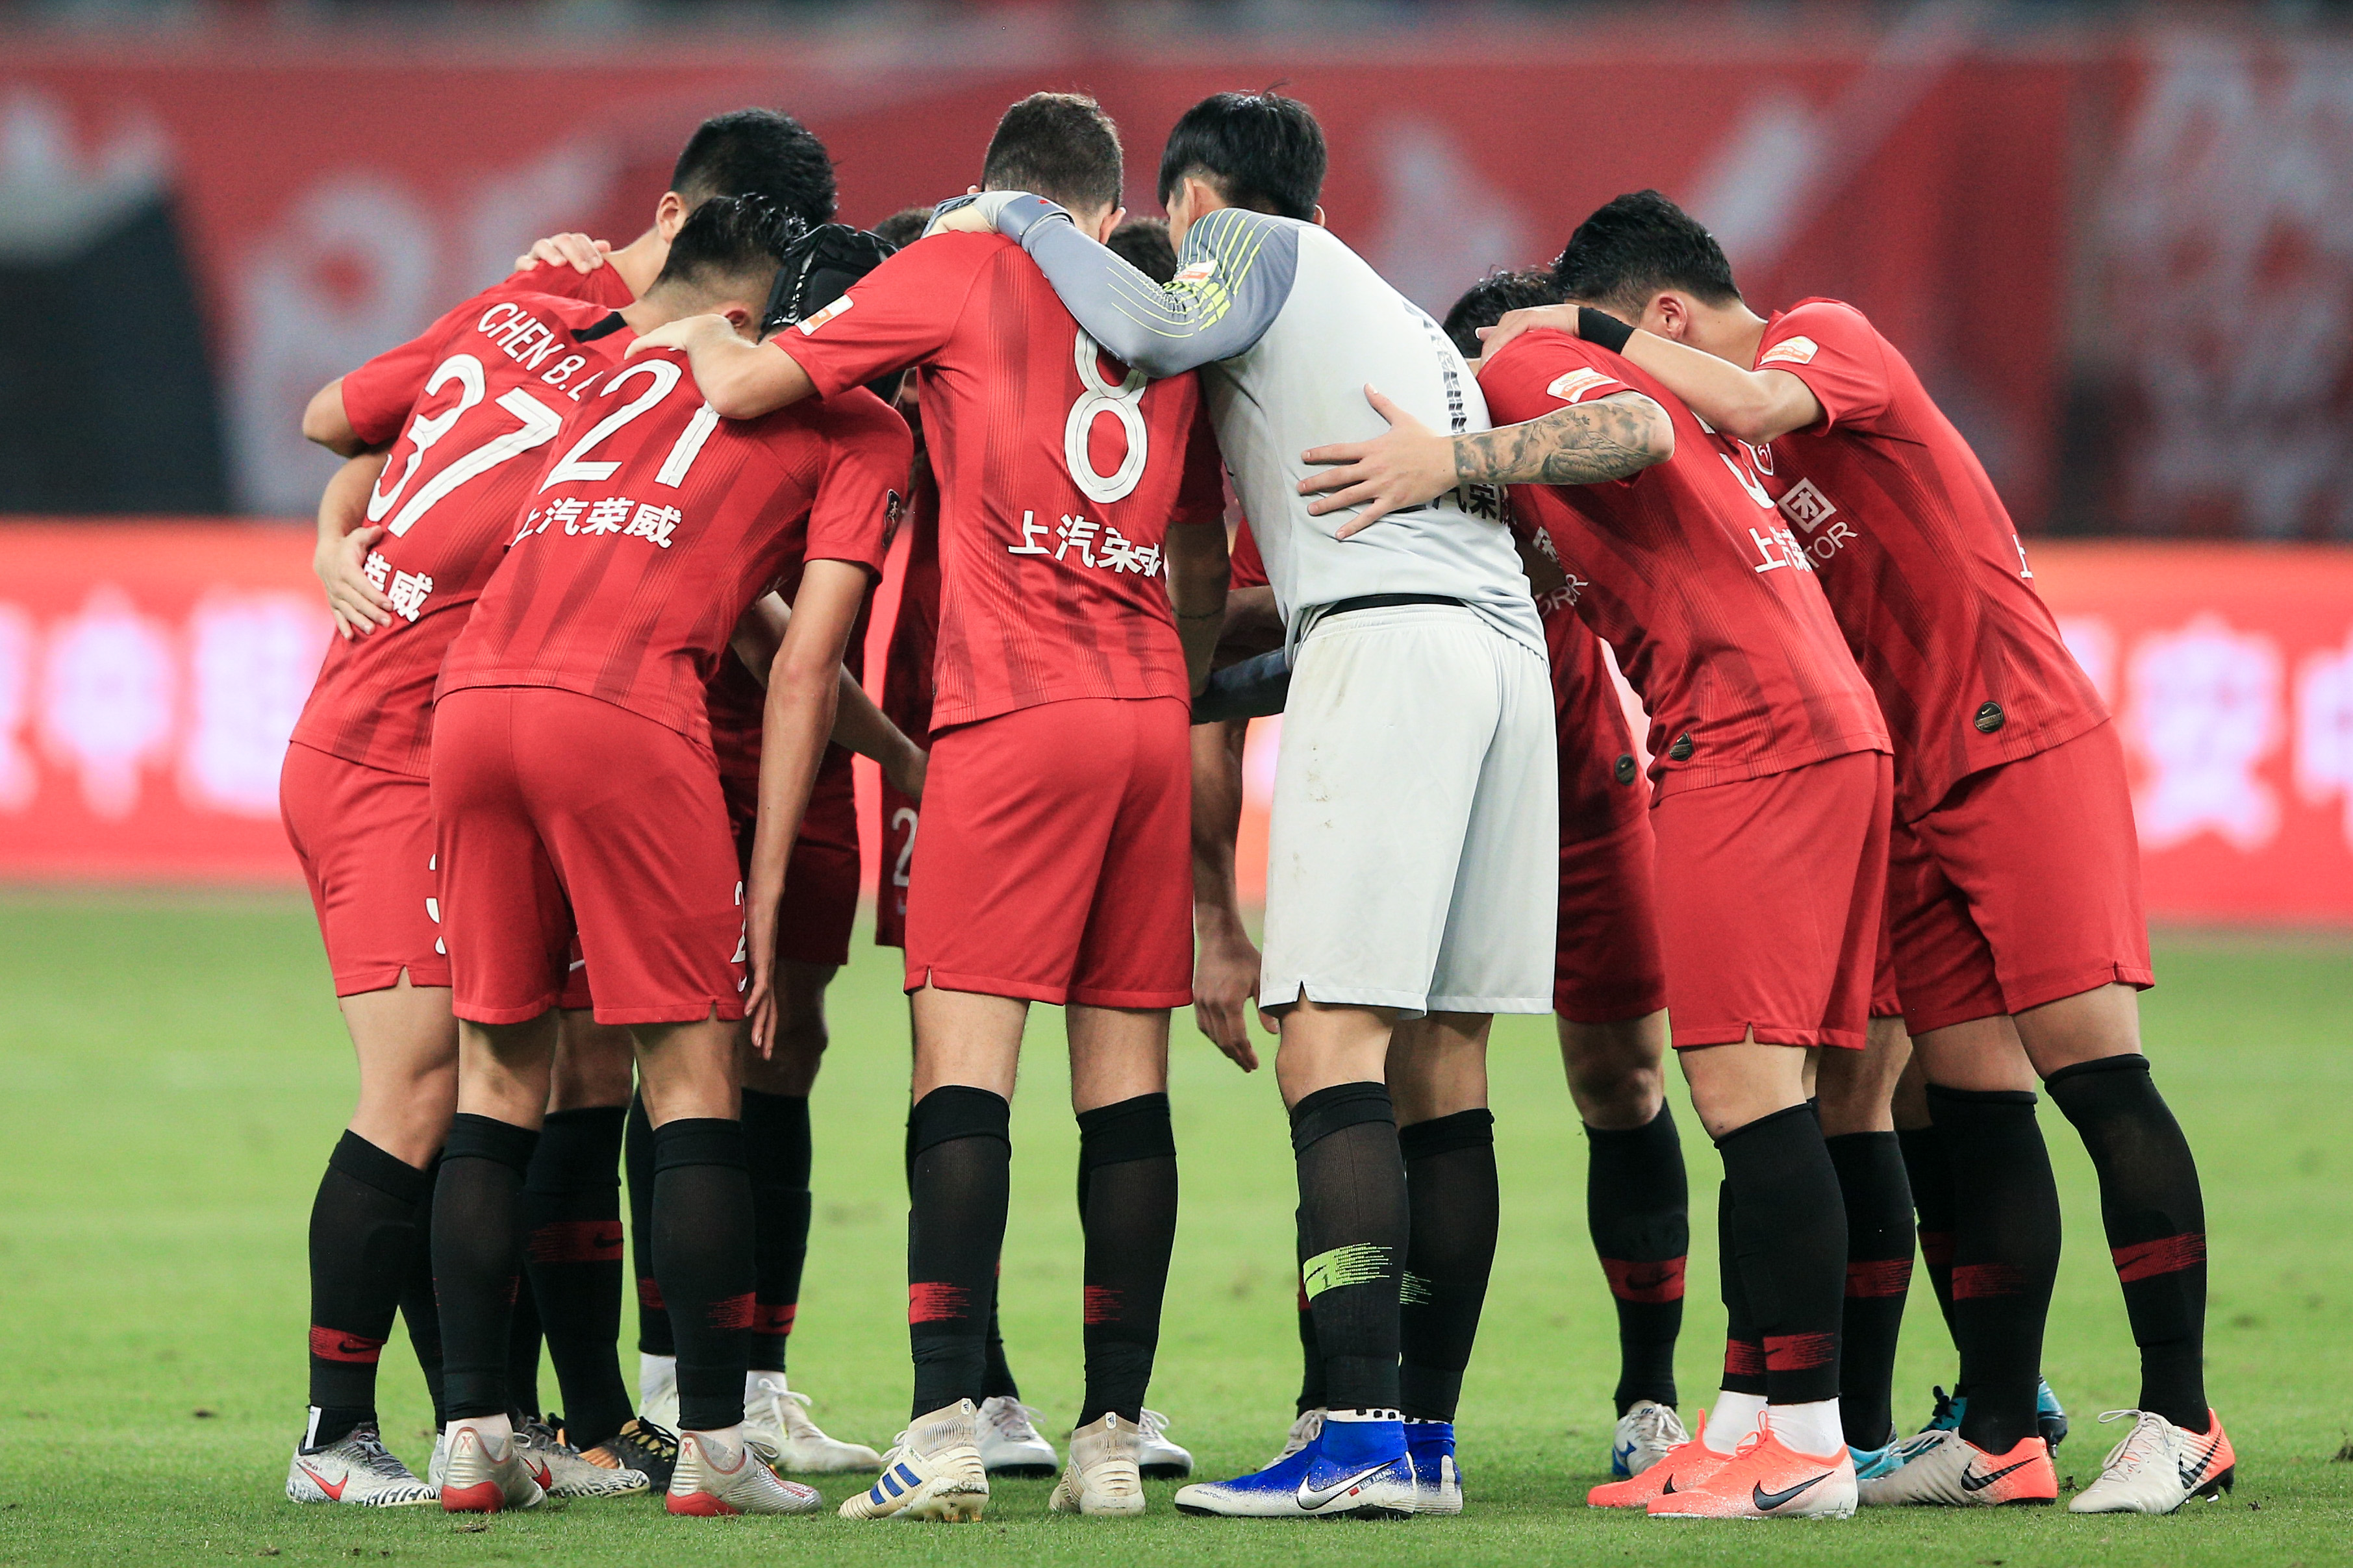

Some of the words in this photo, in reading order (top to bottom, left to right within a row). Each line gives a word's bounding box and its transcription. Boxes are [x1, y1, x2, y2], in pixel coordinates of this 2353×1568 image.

[477, 302, 565, 371] CHEN
[1064, 328, 1148, 503] 8
[367, 354, 563, 538] 37
